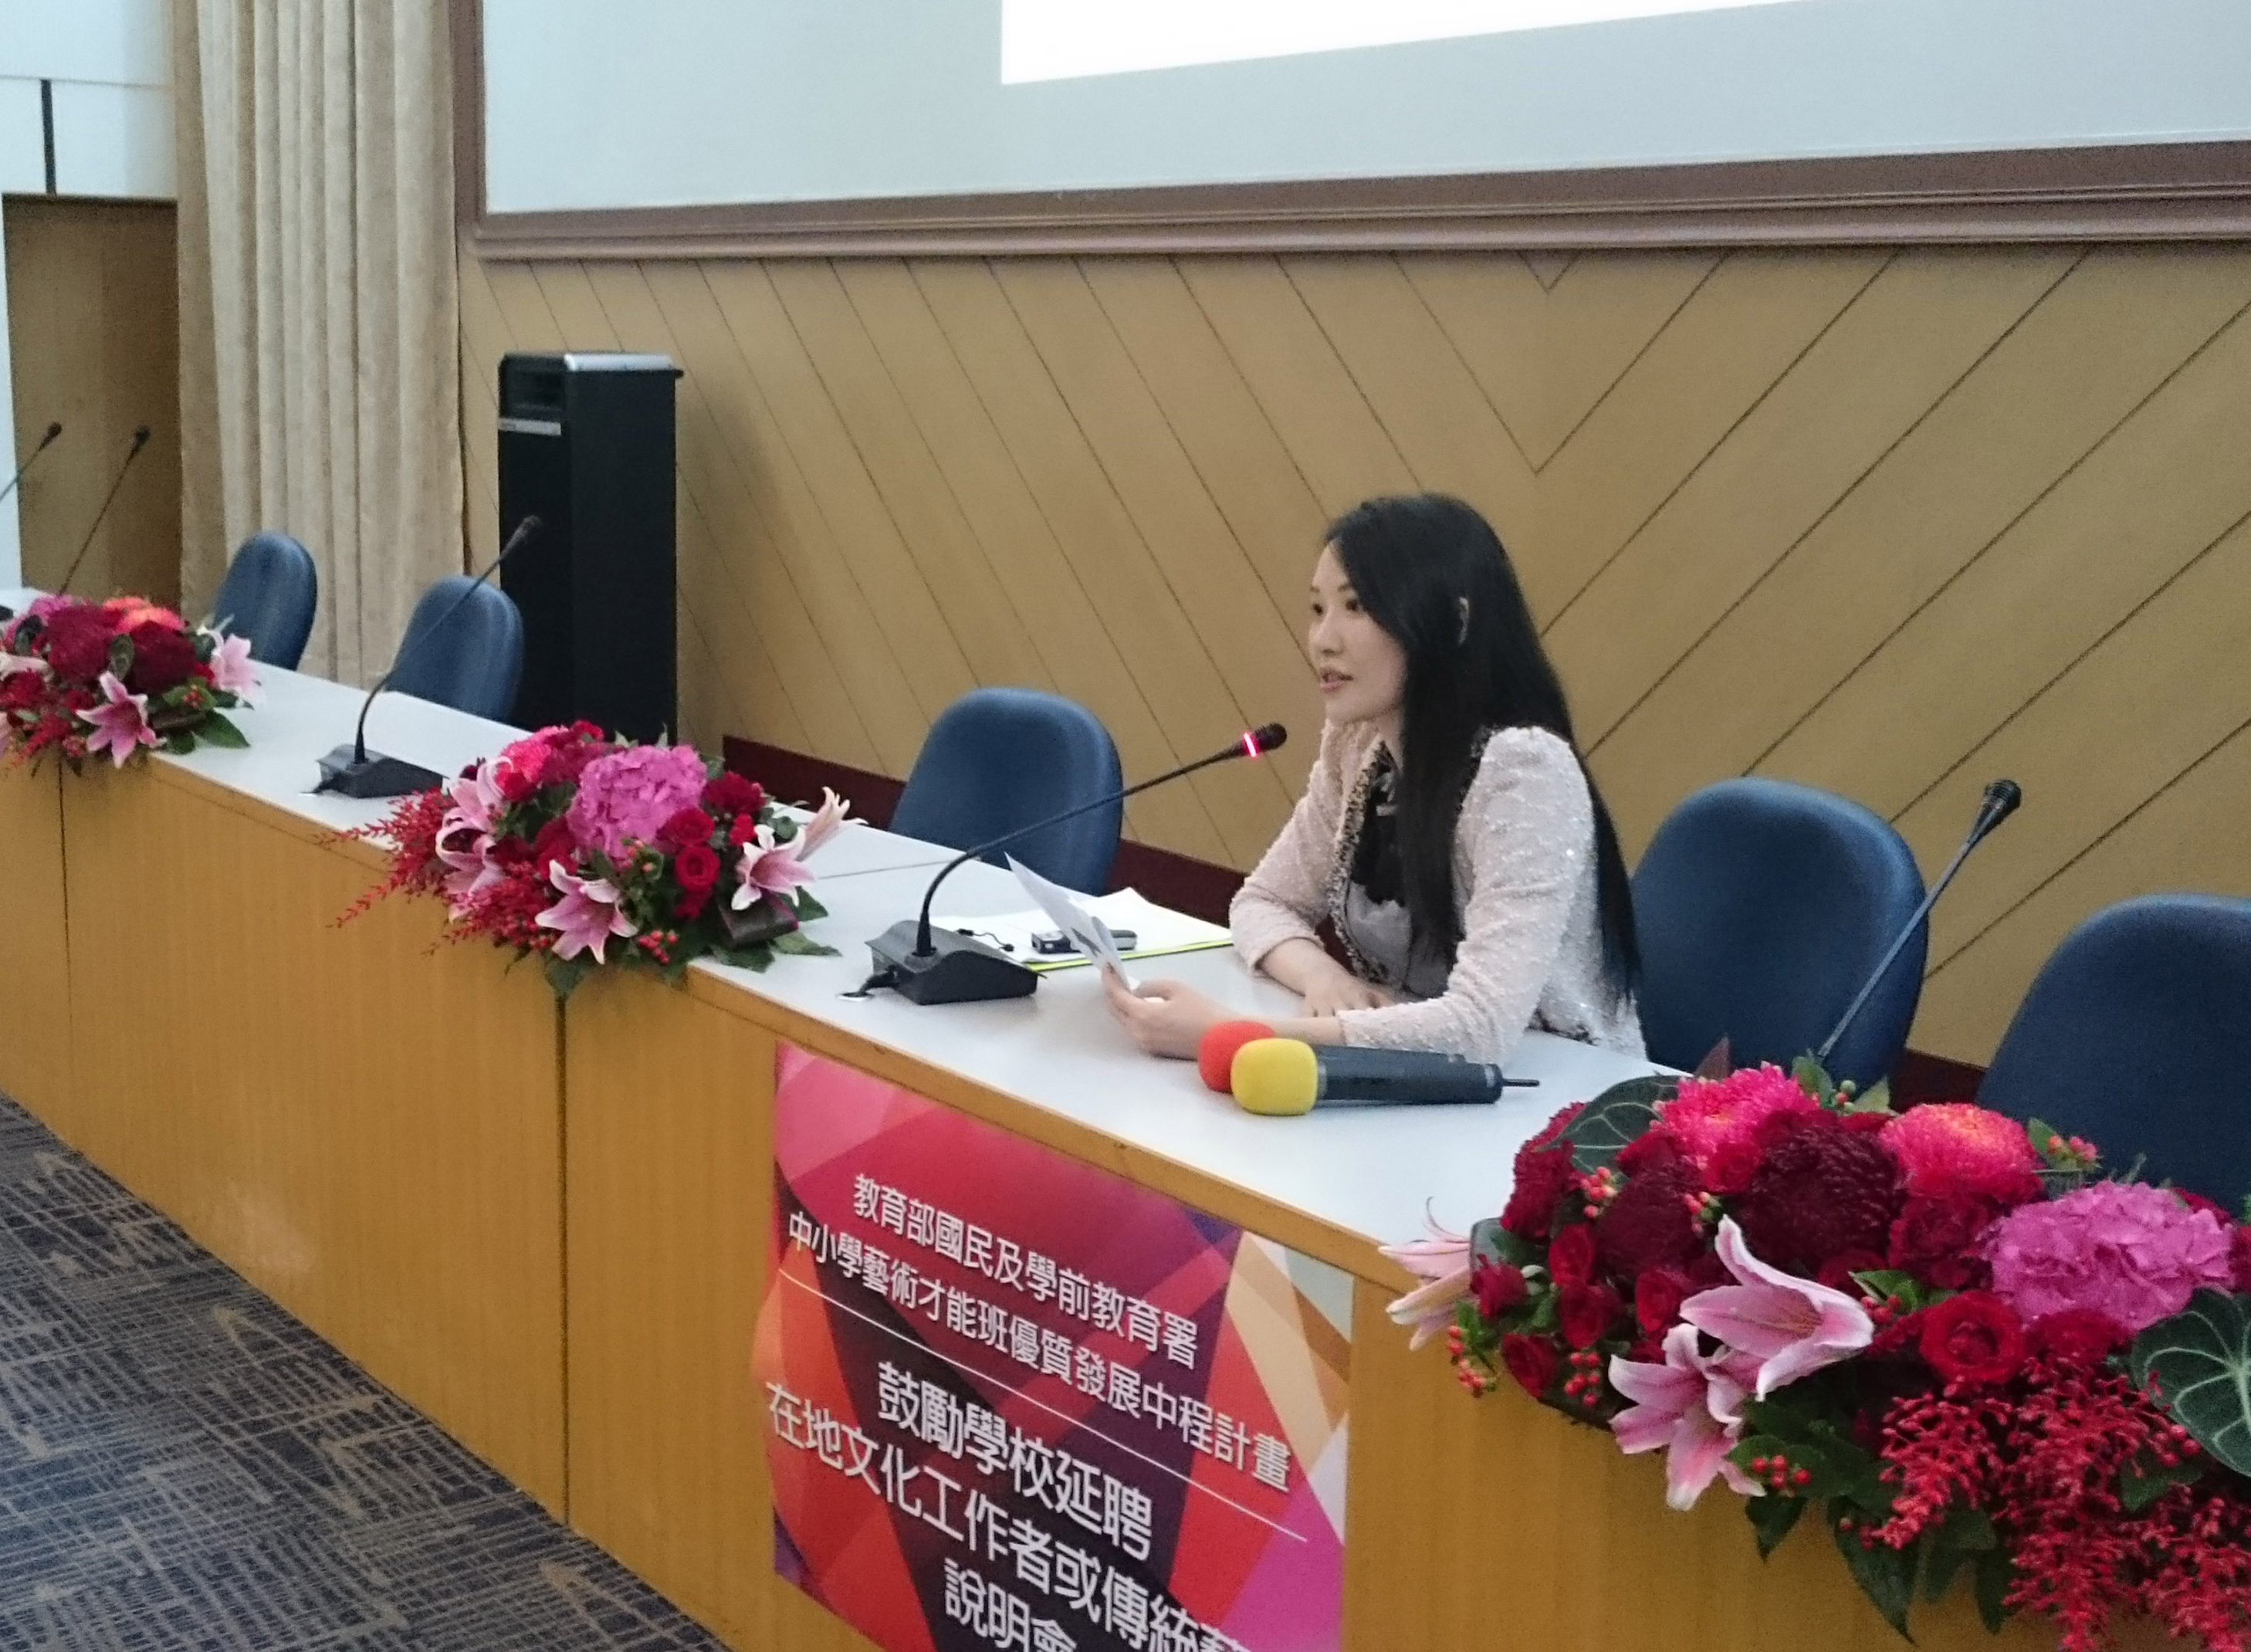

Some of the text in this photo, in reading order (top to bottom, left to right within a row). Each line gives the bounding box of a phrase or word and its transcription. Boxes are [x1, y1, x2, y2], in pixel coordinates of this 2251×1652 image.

[789, 1210, 1291, 1491] 中小學藝術才能班優質發展中程計畫
[853, 1173, 1197, 1369] 教育部國民及學前教育署
[878, 1361, 1153, 1562] 鼓勵學校延聘
